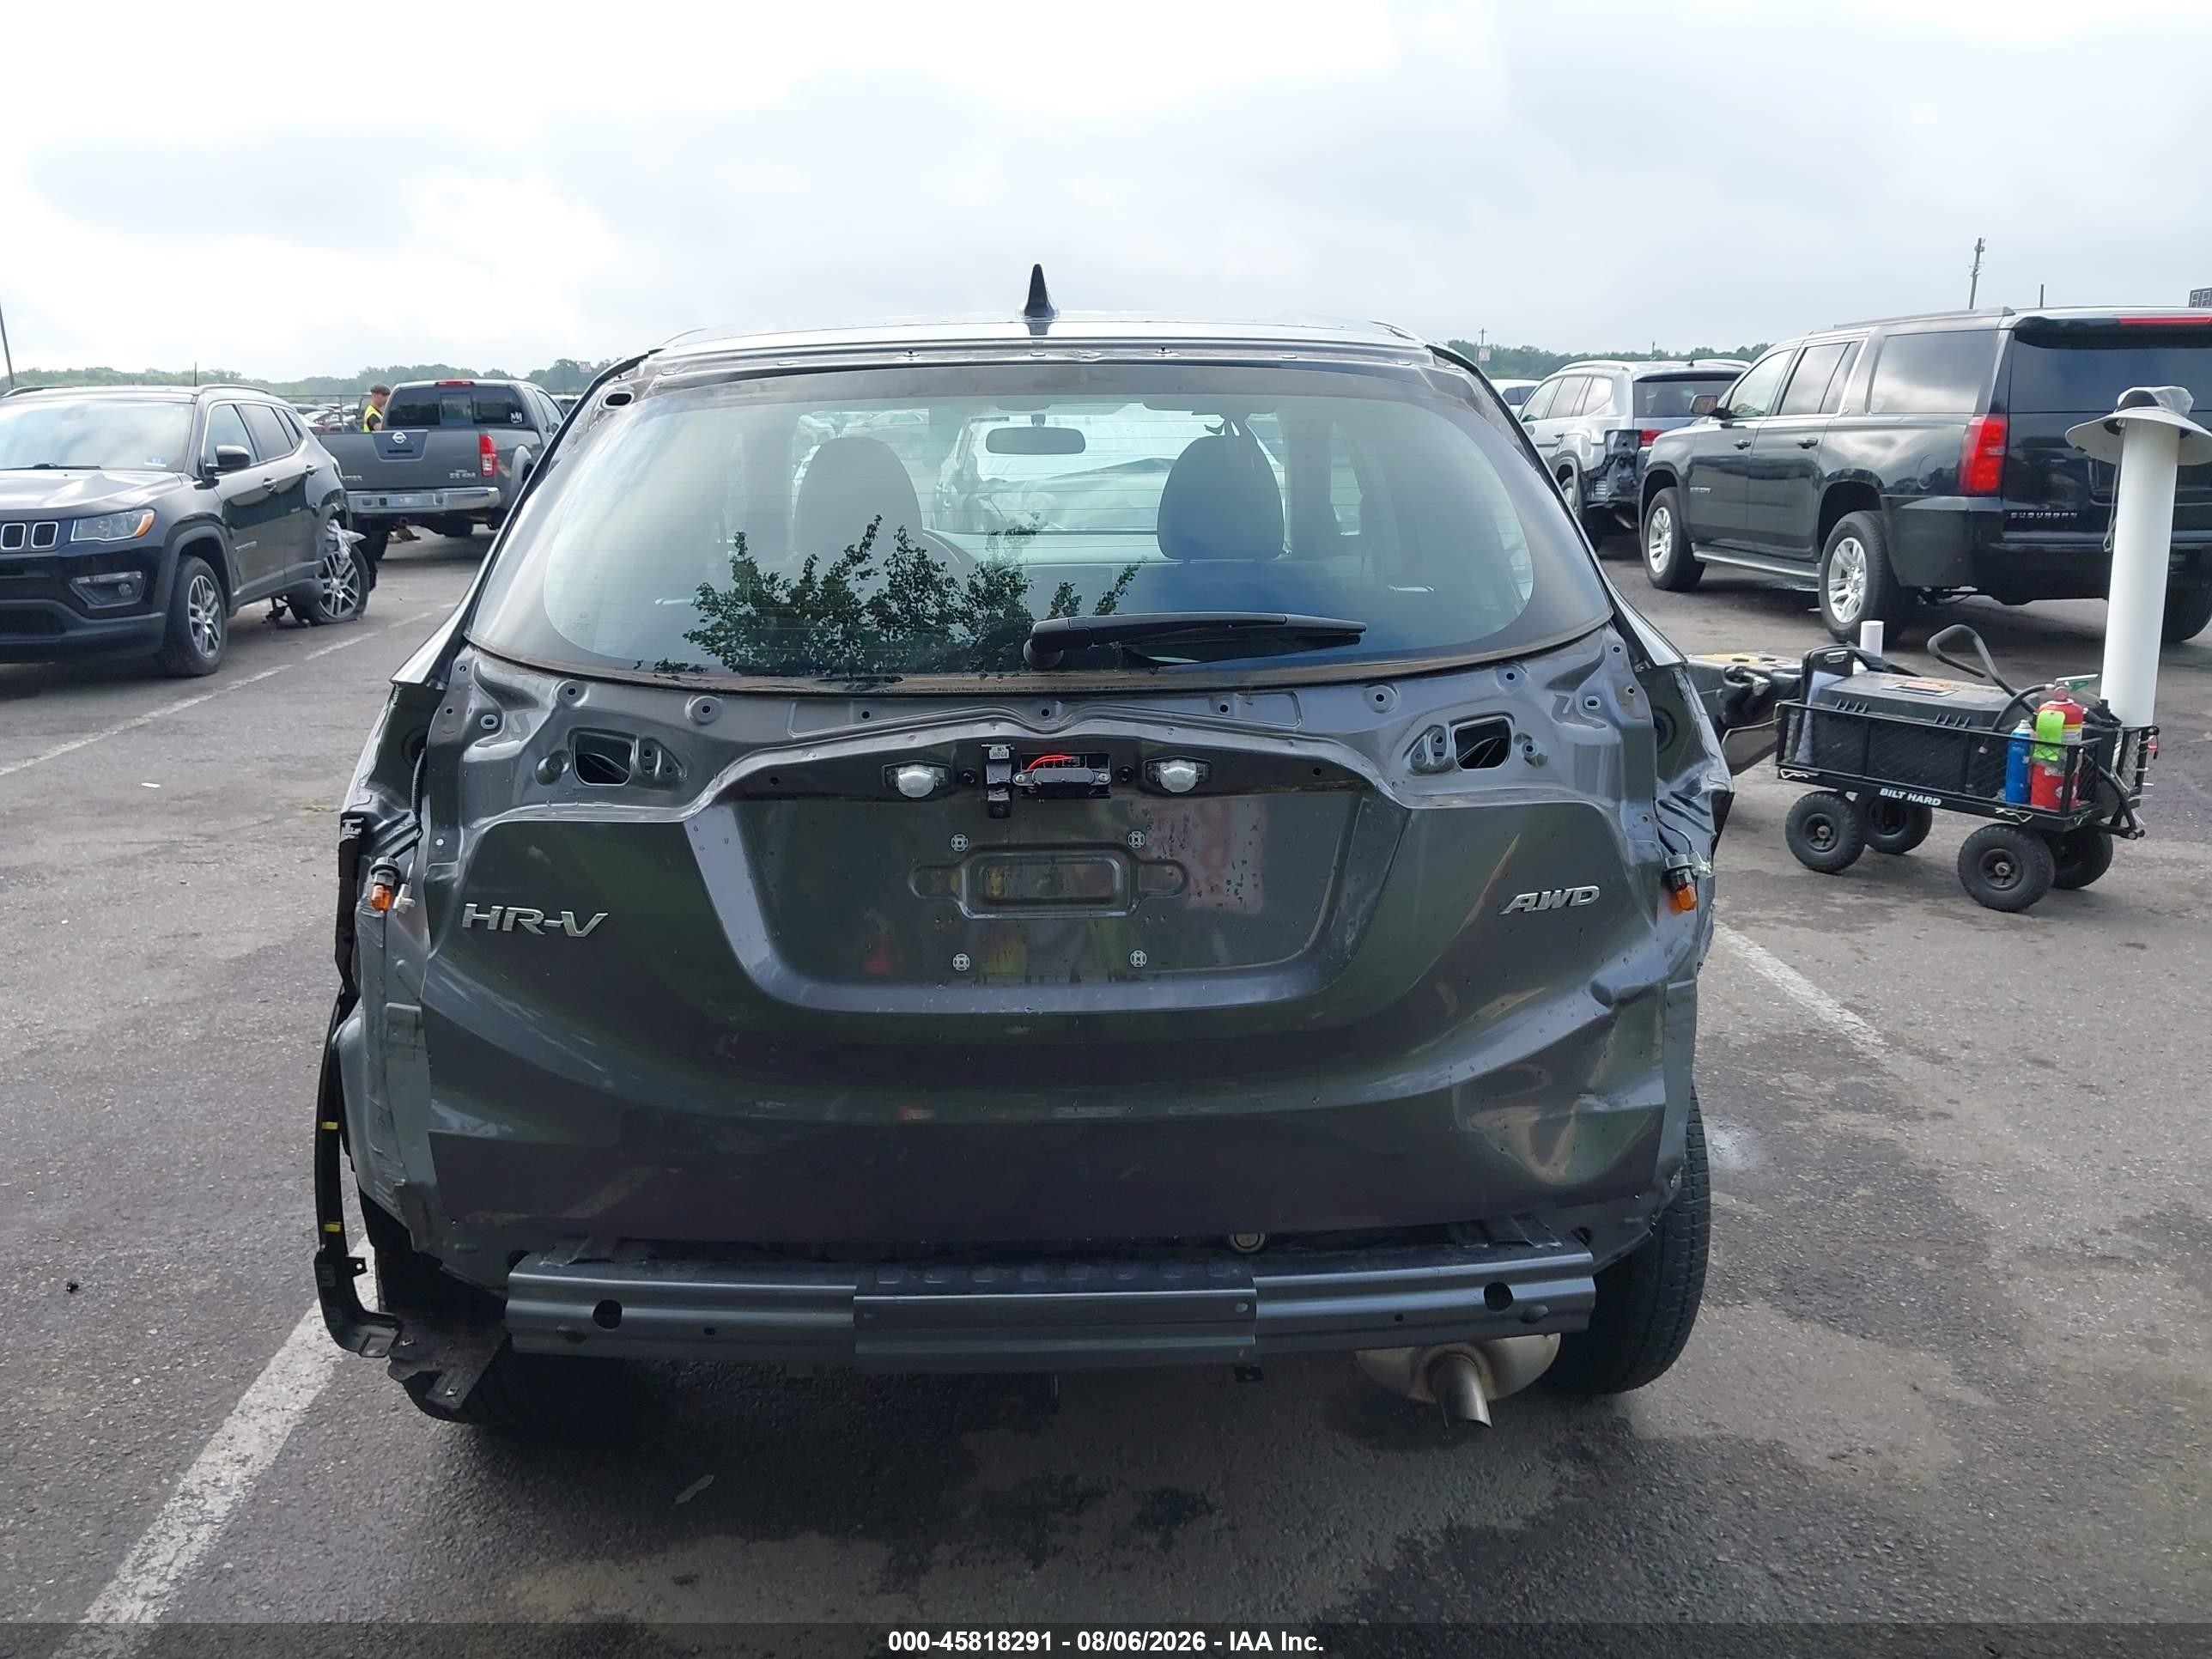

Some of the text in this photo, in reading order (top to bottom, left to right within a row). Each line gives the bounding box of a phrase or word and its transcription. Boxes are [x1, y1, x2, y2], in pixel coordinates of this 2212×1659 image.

[1879, 787, 1942, 806] BILT HARD
[1498, 884, 1600, 915] AWD
[461, 902, 609, 938] HR-V
